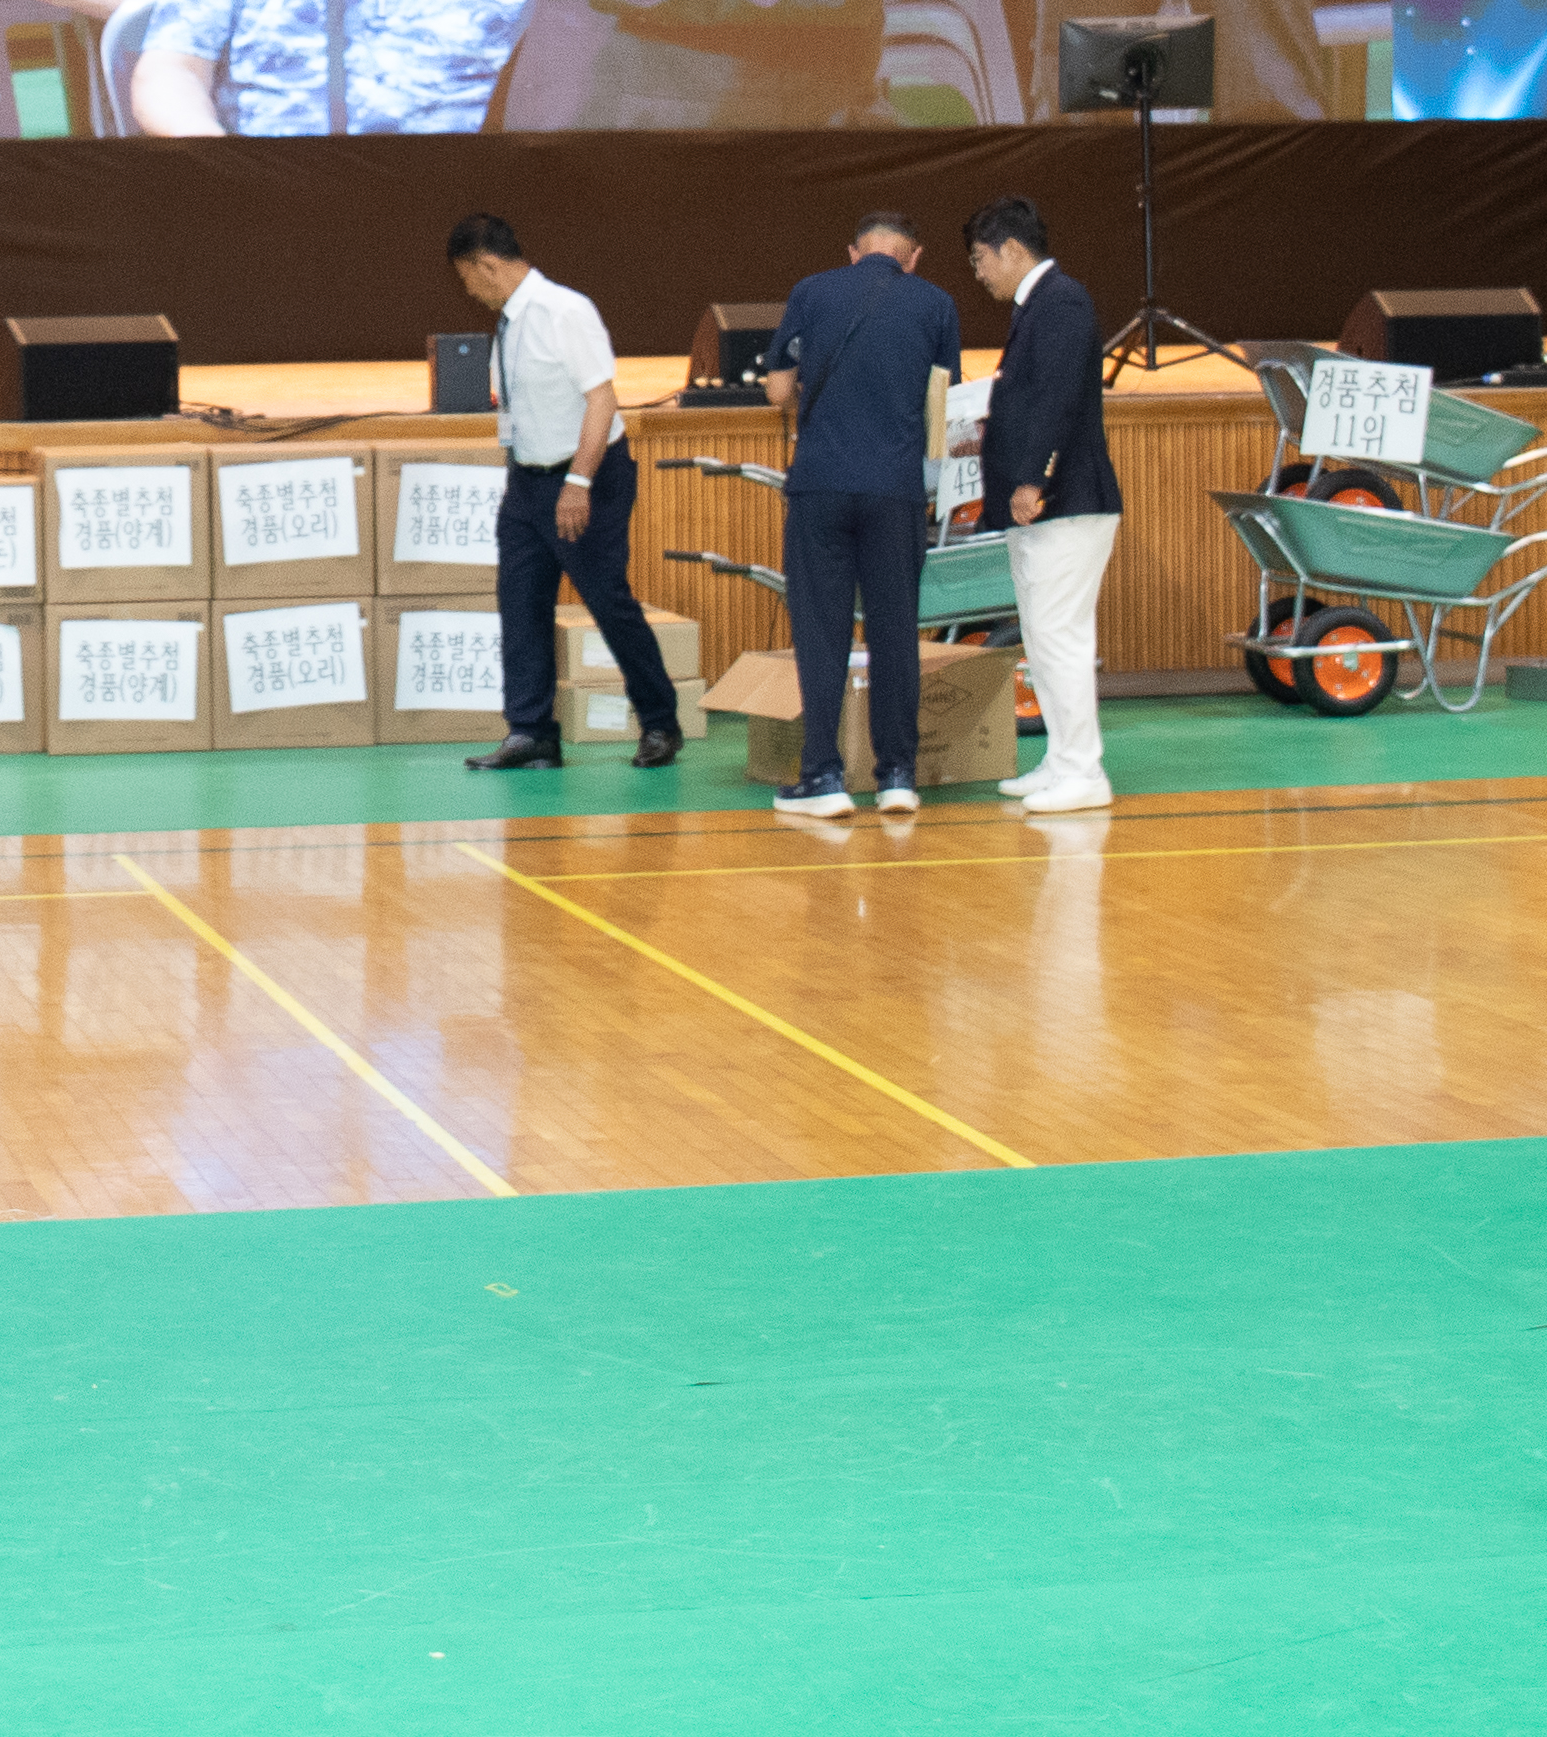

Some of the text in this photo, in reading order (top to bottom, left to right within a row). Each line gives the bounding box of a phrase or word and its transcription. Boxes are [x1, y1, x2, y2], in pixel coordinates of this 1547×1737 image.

[1315, 365, 1419, 415] 경품추첨
[1330, 413, 1386, 456] 11위
[71, 486, 172, 518] 축종별추첨
[235, 477, 337, 514] 축종별추첨
[75, 518, 172, 551] 경품(양계)
[241, 510, 338, 546] 경품(오리)
[408, 515, 493, 546] 경품(염소
[76, 640, 180, 672] 축종별추첨
[242, 623, 345, 659] 축종별추첨
[79, 672, 178, 703] 경품(양계)
[248, 655, 347, 694] 경품(오리)
[411, 662, 497, 693] 경품(염소
